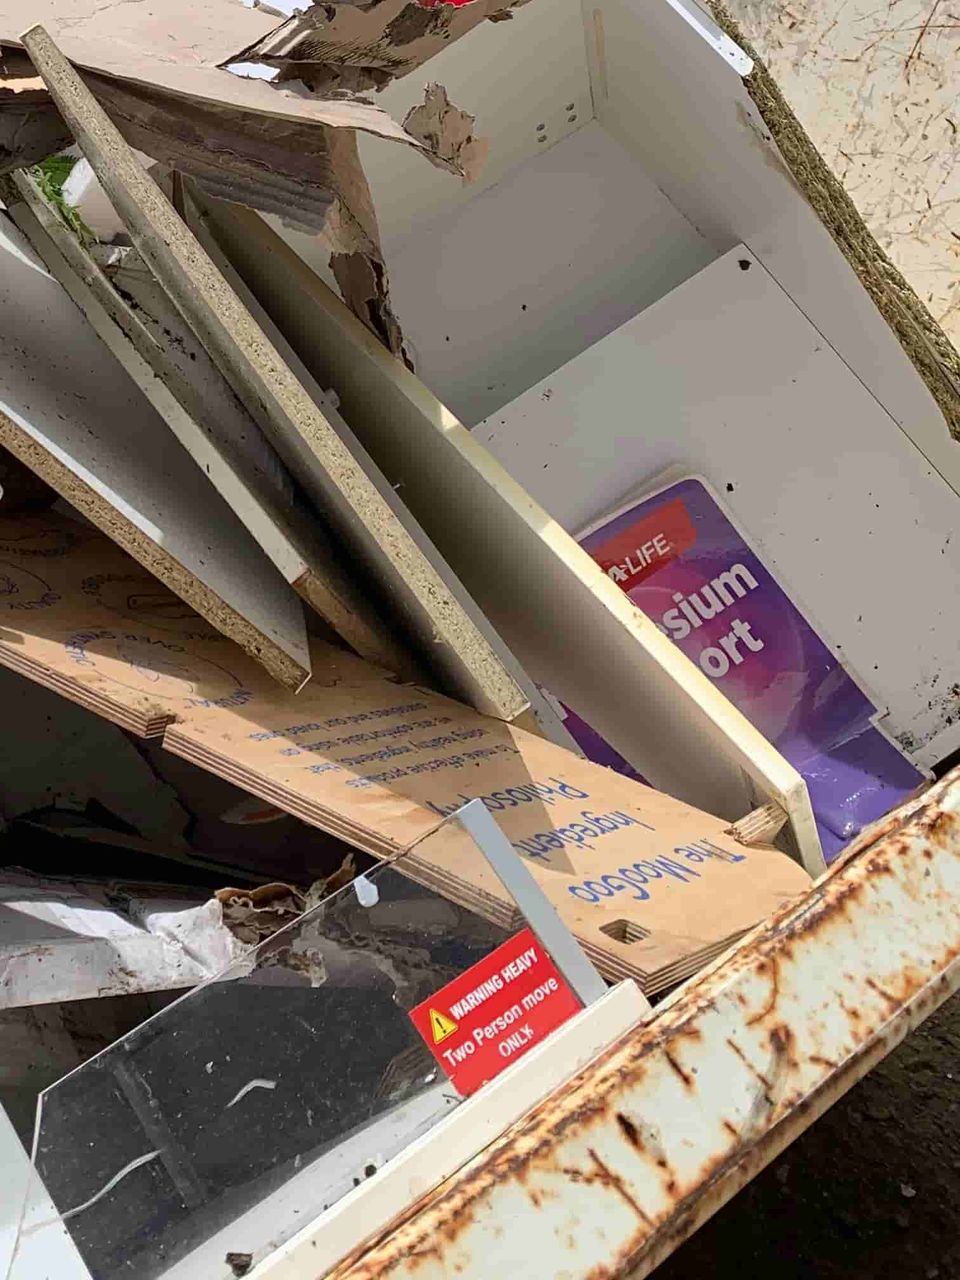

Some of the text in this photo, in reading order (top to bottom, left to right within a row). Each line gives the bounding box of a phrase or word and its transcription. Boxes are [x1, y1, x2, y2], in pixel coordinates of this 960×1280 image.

[655, 563, 759, 640] sium
[699, 618, 765, 678] ort
[512, 810, 656, 863] Ingredient
[568, 839, 747, 903] The MooGoo
[449, 947, 539, 1021] WARNING HEAVY
[442, 976, 559, 1068] Two Person move
[498, 1023, 535, 1058] ONLY
